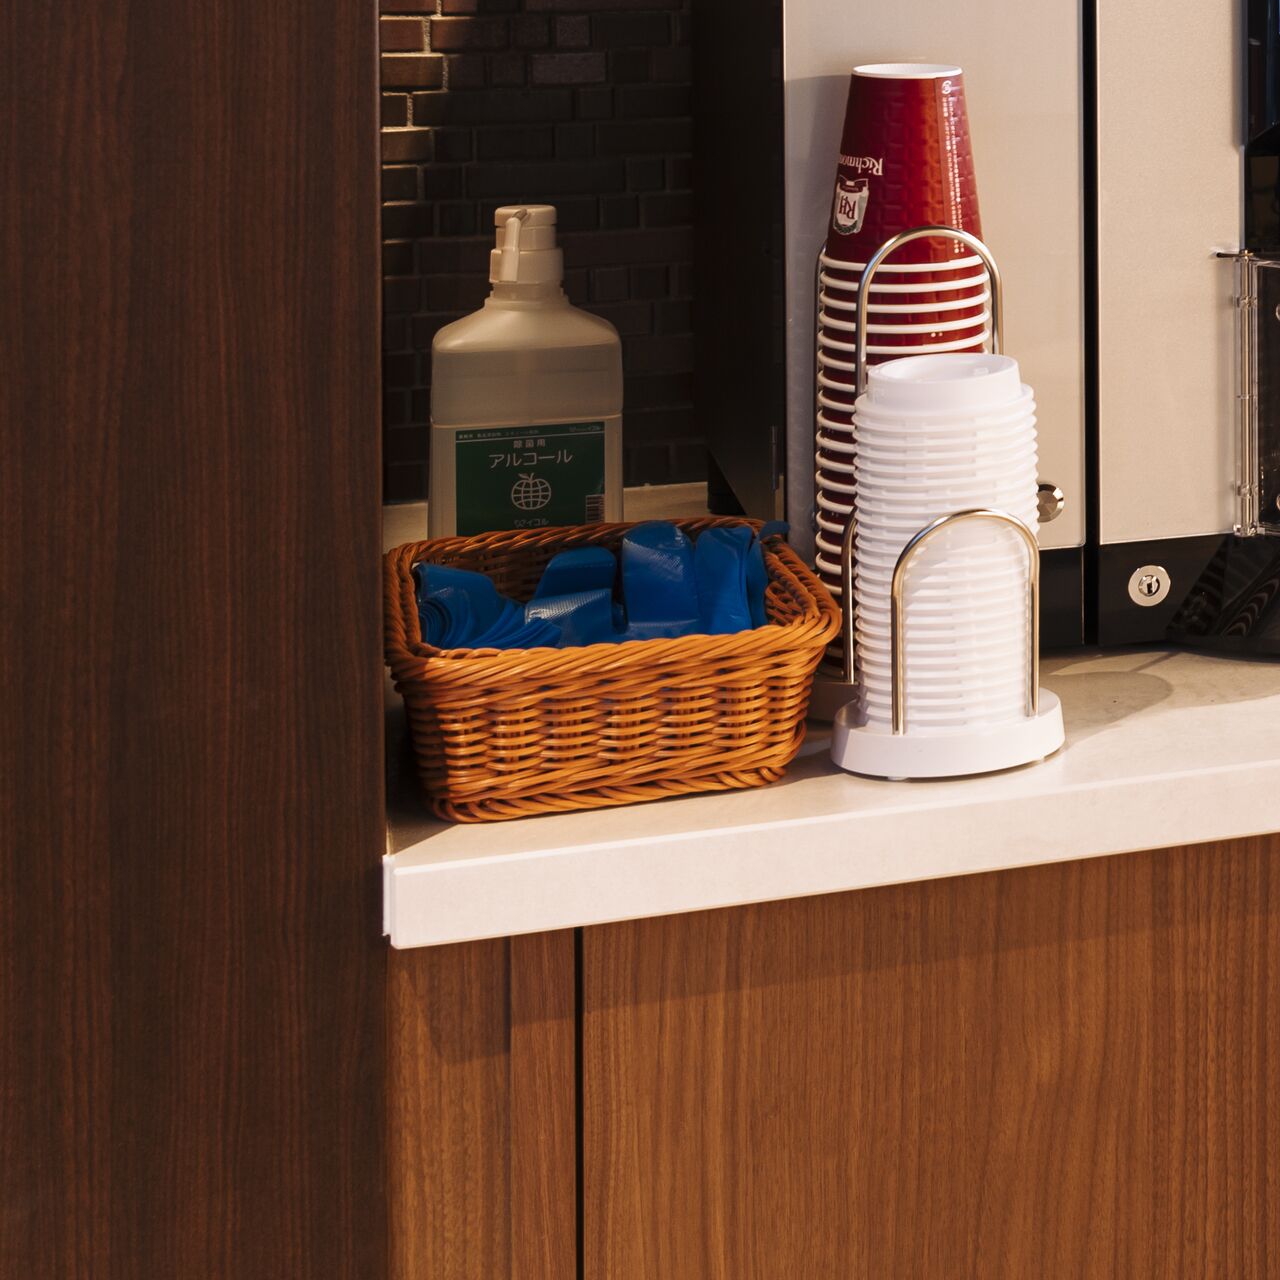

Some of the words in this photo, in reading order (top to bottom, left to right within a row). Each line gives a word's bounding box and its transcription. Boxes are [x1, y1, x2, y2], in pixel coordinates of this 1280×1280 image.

[488, 449, 574, 469] アルコール
